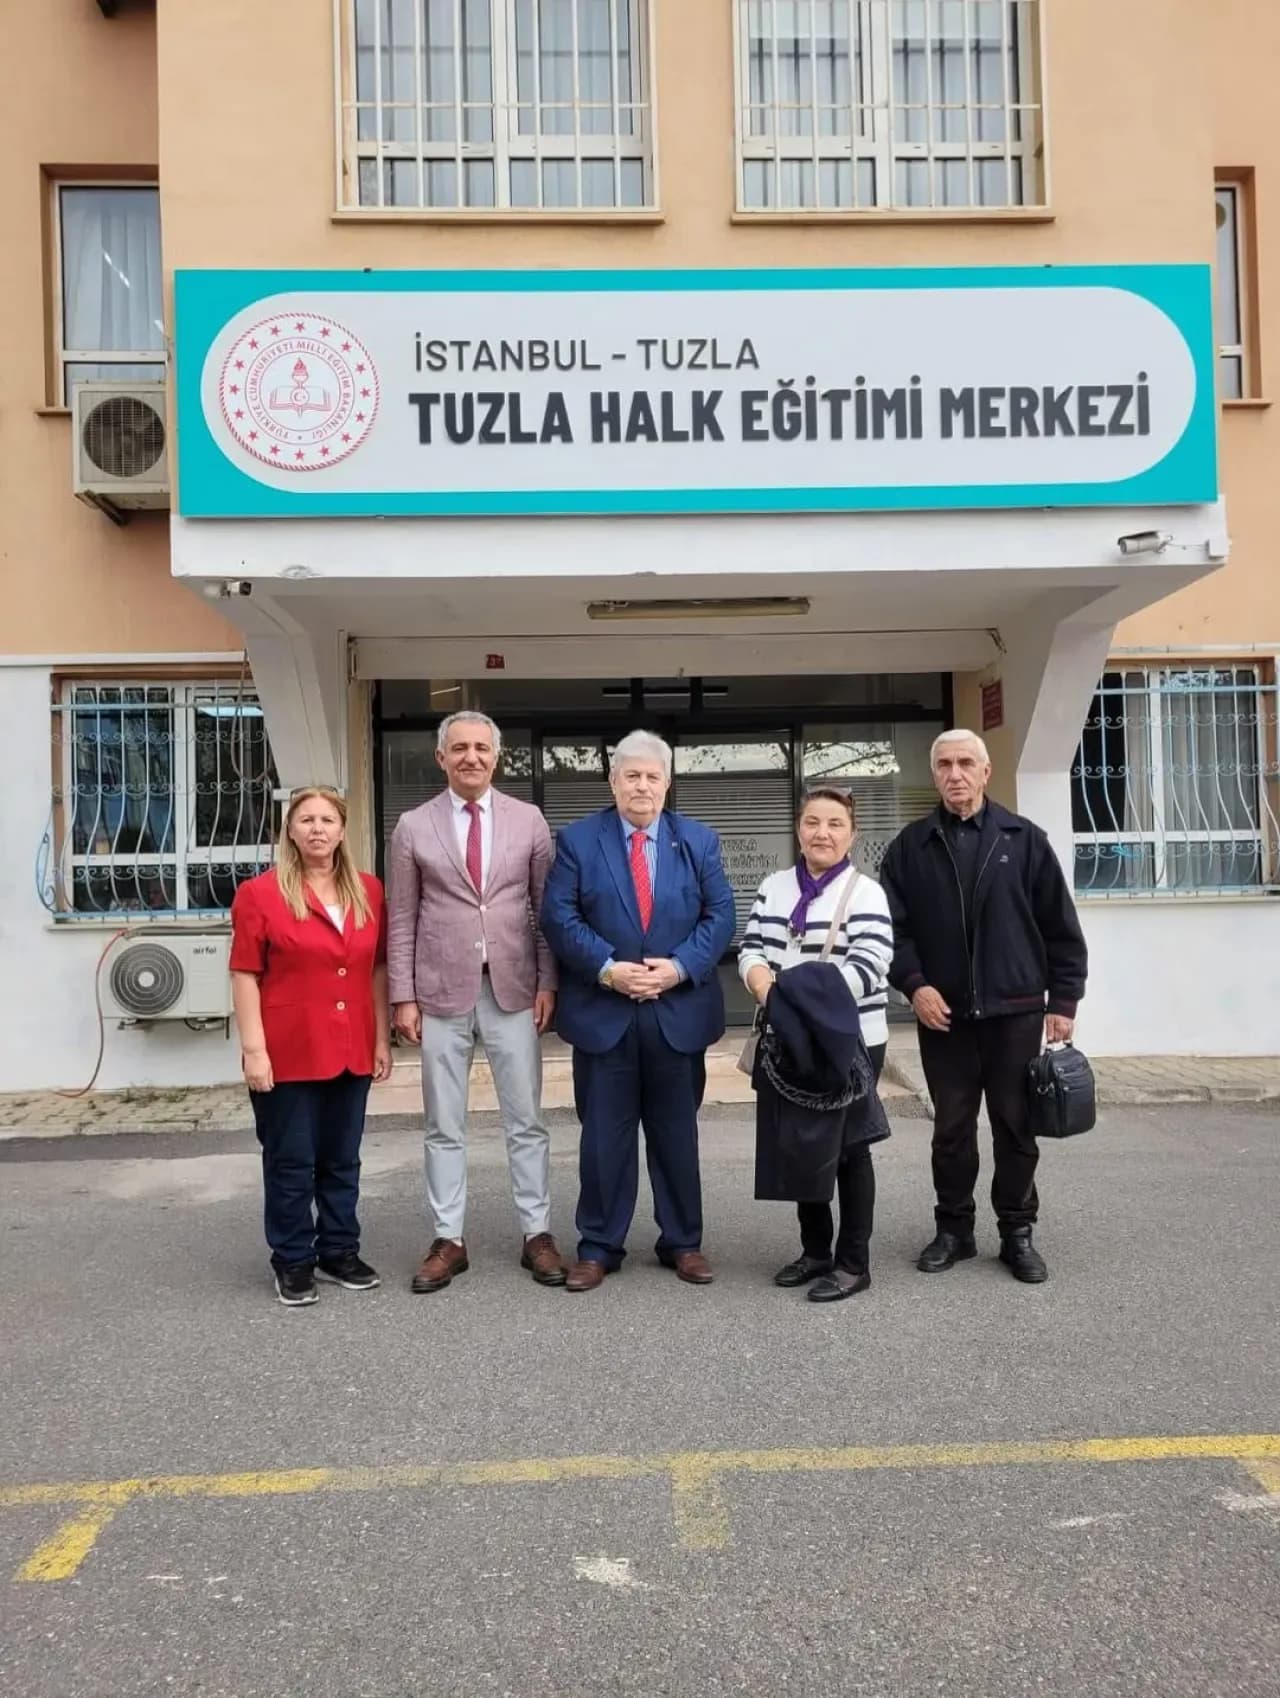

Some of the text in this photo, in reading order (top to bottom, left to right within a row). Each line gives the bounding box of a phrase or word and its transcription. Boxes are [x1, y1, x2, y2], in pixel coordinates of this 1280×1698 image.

[416, 332, 601, 370] İSTANBUL
[637, 338, 759, 369] TUZLA
[409, 371, 1150, 443] TUZLA HALK EĞİTİMİ MERKEZİ
